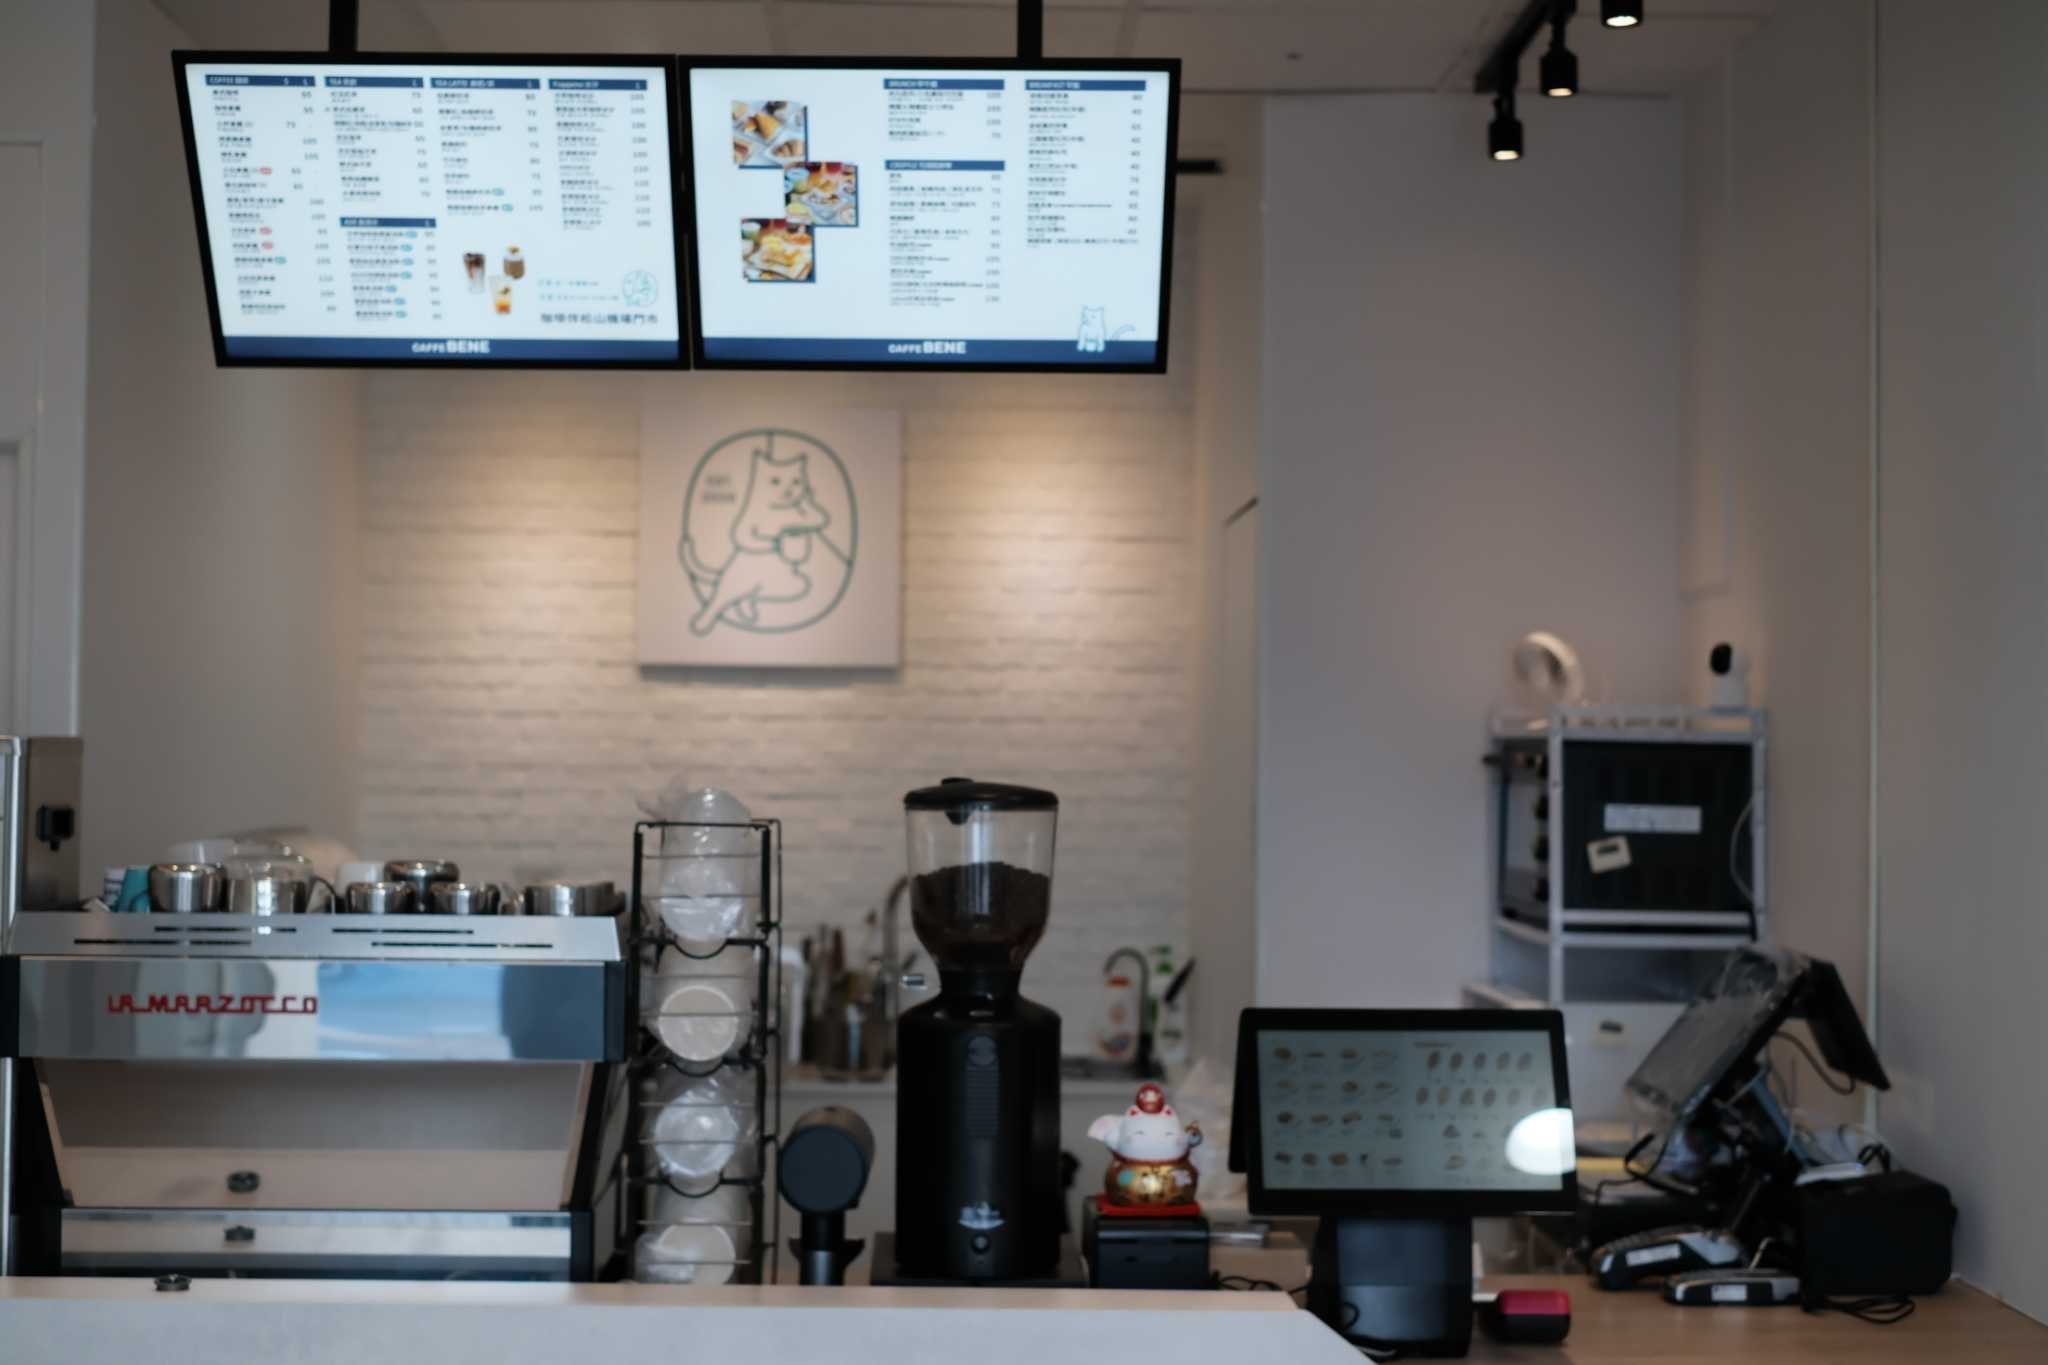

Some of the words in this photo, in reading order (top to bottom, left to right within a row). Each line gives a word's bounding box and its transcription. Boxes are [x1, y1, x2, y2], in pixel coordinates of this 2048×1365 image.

[411, 343, 446, 354] CAFFE
[447, 340, 490, 354] BENE
[888, 343, 921, 354] CAFFE
[923, 341, 966, 354] BENE
[107, 995, 133, 1013] LA
